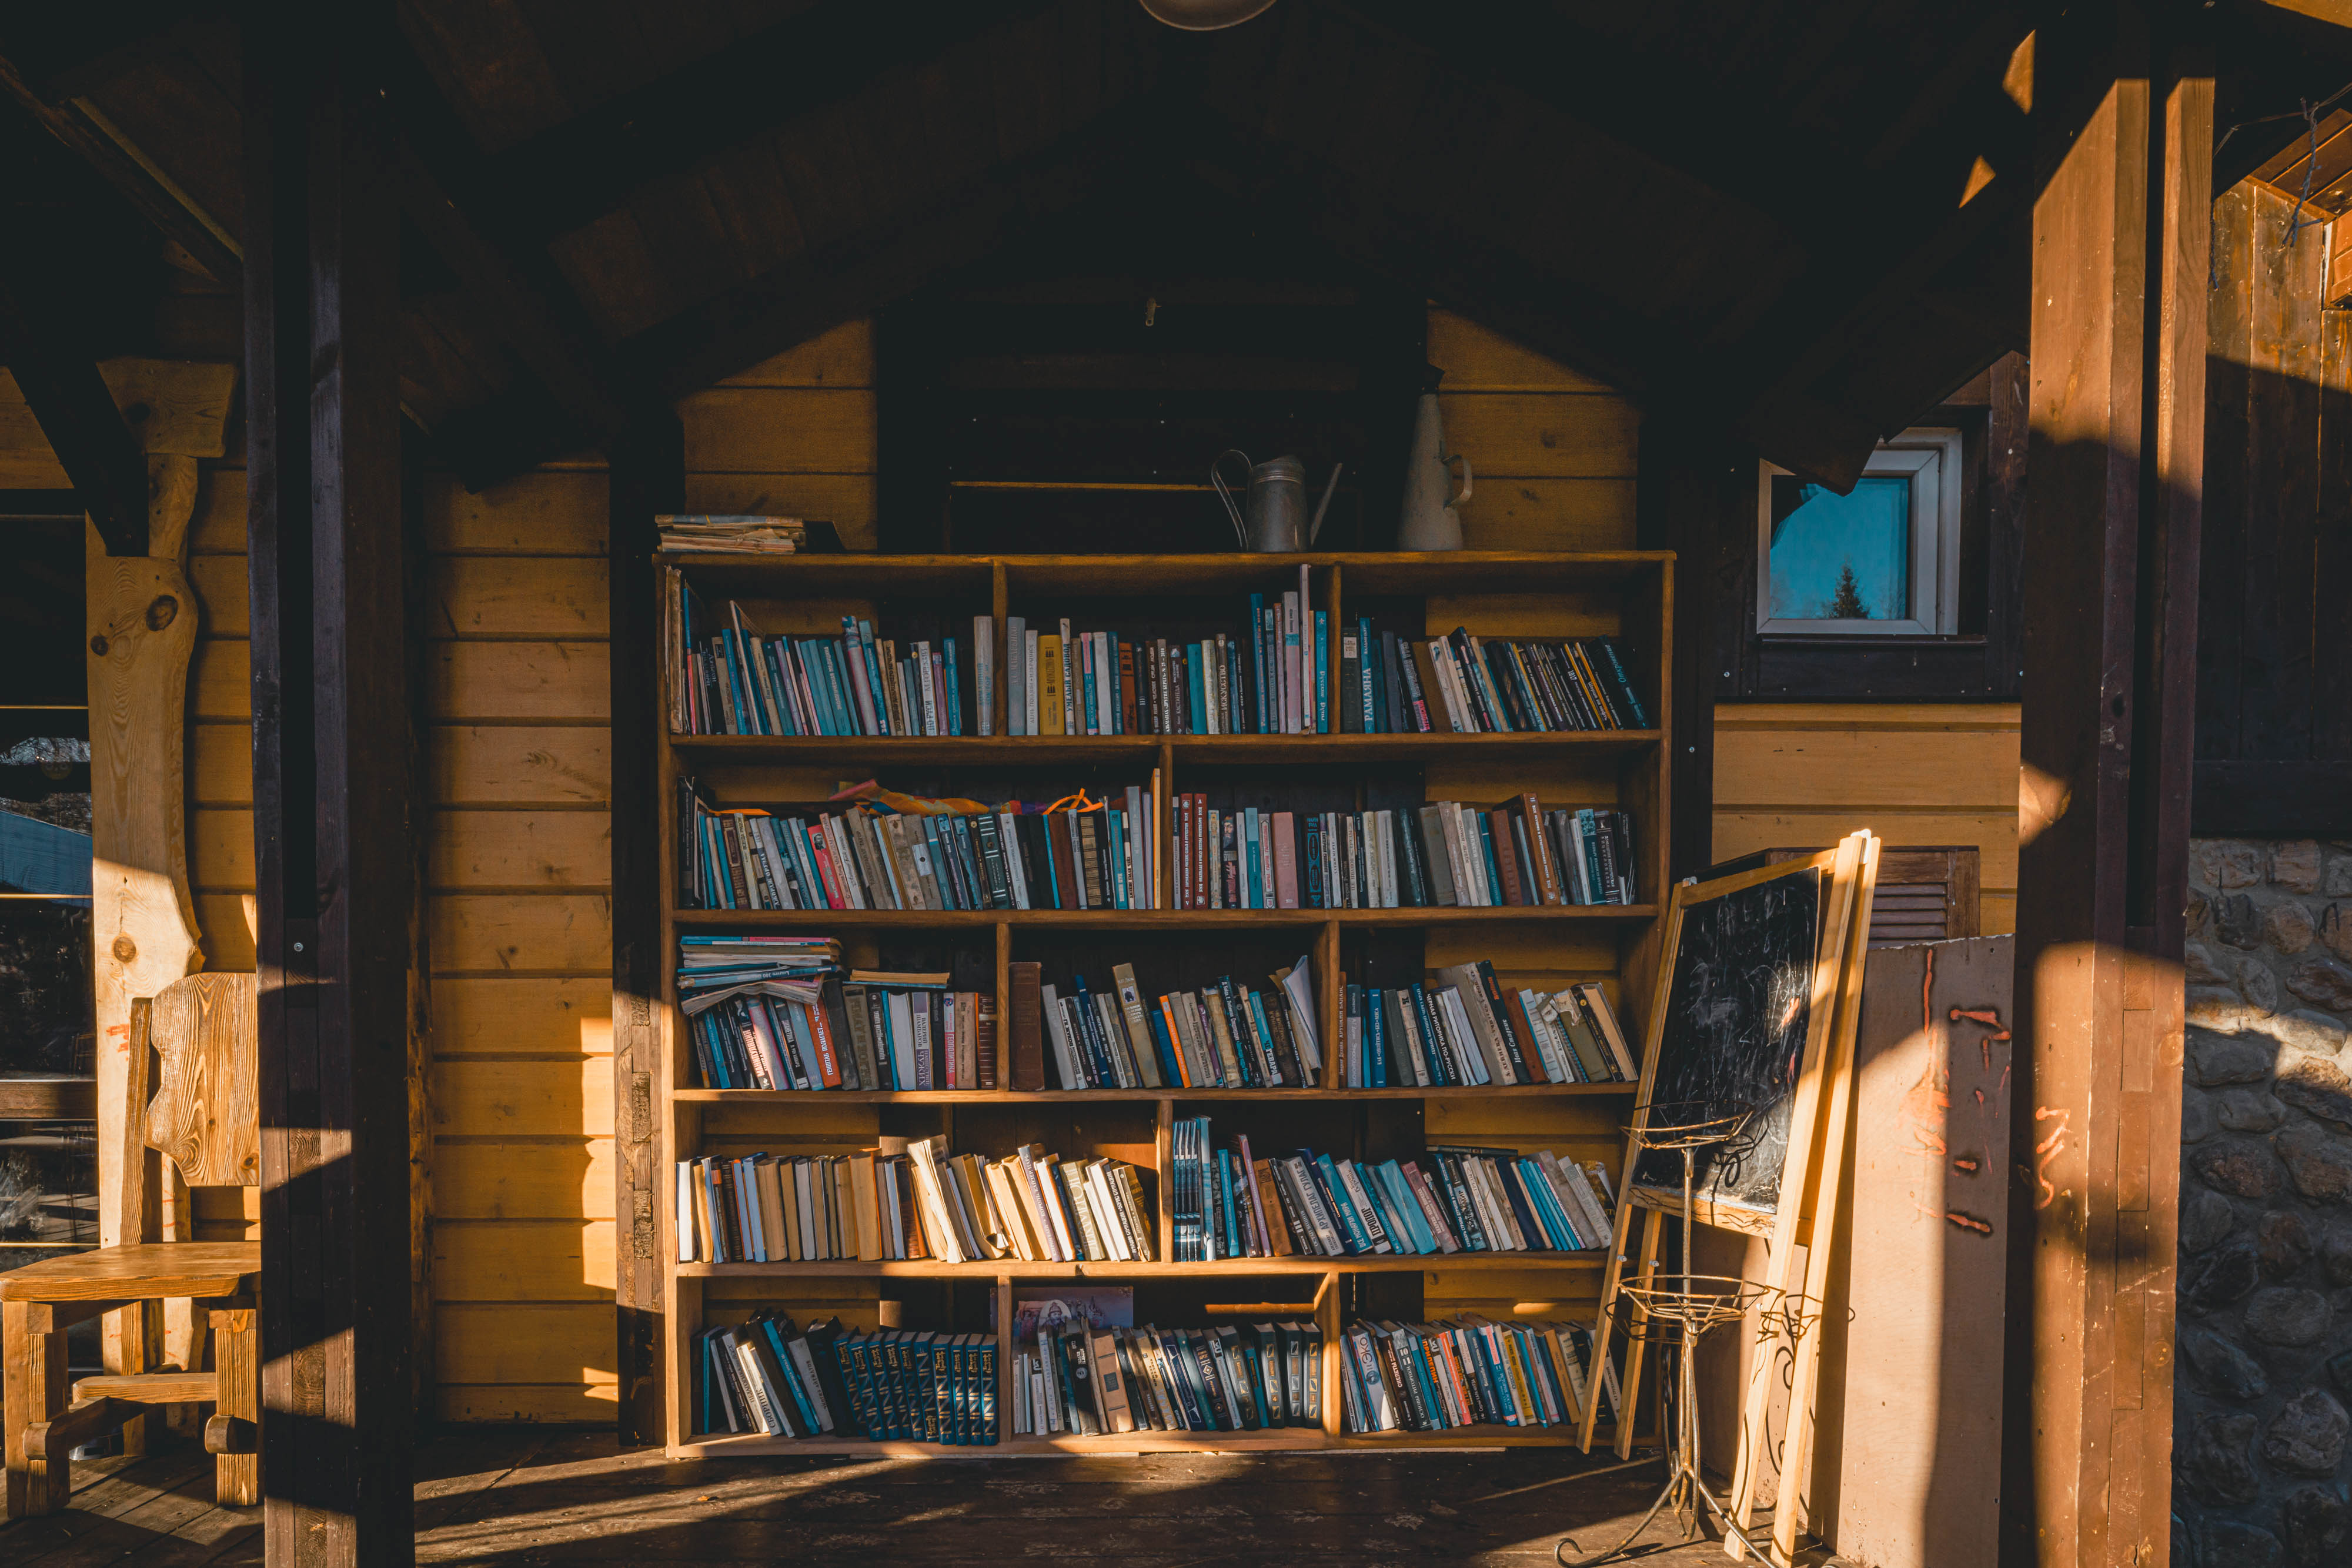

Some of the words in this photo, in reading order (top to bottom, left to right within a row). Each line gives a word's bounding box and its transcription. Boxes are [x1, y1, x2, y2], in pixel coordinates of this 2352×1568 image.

[1063, 643, 1071, 677] САДОВОД
[1605, 644, 1626, 683] Откровение
[1064, 680, 1073, 711] УМЕЛЫЙ
[1219, 664, 1227, 710] ИСКУССТВО
[1362, 668, 1372, 721] РАМАЯНА
[760, 852, 771, 876] ОРУЭЛЛ
[767, 877, 780, 906] ДЖОРДЖ
[817, 1022, 828, 1051] ПОЛАГАЕТ...
[1263, 1040, 1271, 1049] ЧЕ
[1425, 994, 1436, 1015] ЧЕРНАЯ
[1432, 1015, 1445, 1046] РИТОРИКА
[1442, 1046, 1456, 1079] ПО-РУССКИ
[1502, 1019, 1516, 1047] Стаднюк
[823, 1052, 833, 1075] ГЕНШТАБ
[947, 1033, 955, 1073] ГЕОПОЛИТИКА
[1265, 1048, 1278, 1075] ГЕВАРА
[1512, 1049, 1521, 1062] Иван
[917, 1051, 925, 1086] ЧУЖИХ
[1297, 1170, 1312, 1191] ГУЛАГ
[1348, 1170, 1360, 1192] Боровик
[1114, 1196, 1123, 1209] БОРИС
[1307, 1193, 1329, 1231] АРХИПЕЛАГ
[1341, 1202, 1354, 1218] МИРА
[1348, 1218, 1362, 1238] МОНАРХИ
[1361, 1208, 1382, 1236] ПРОЛОГ
[1358, 1239, 1366, 1248] ВСЕ
[1391, 1362, 1403, 1388] СКЕЛЕТЫ
[1422, 1340, 1439, 1383] ПРИЛЕПИН
[738, 1368, 755, 1402] ПЕДАГОГИКА
[1406, 1366, 1418, 1394] РИТОРИКИ
[1481, 1367, 1489, 1386] Возлюби
[757, 1388, 776, 1428] СБОРНИК
[1415, 1396, 1424, 1419] ОСНОВЫ
